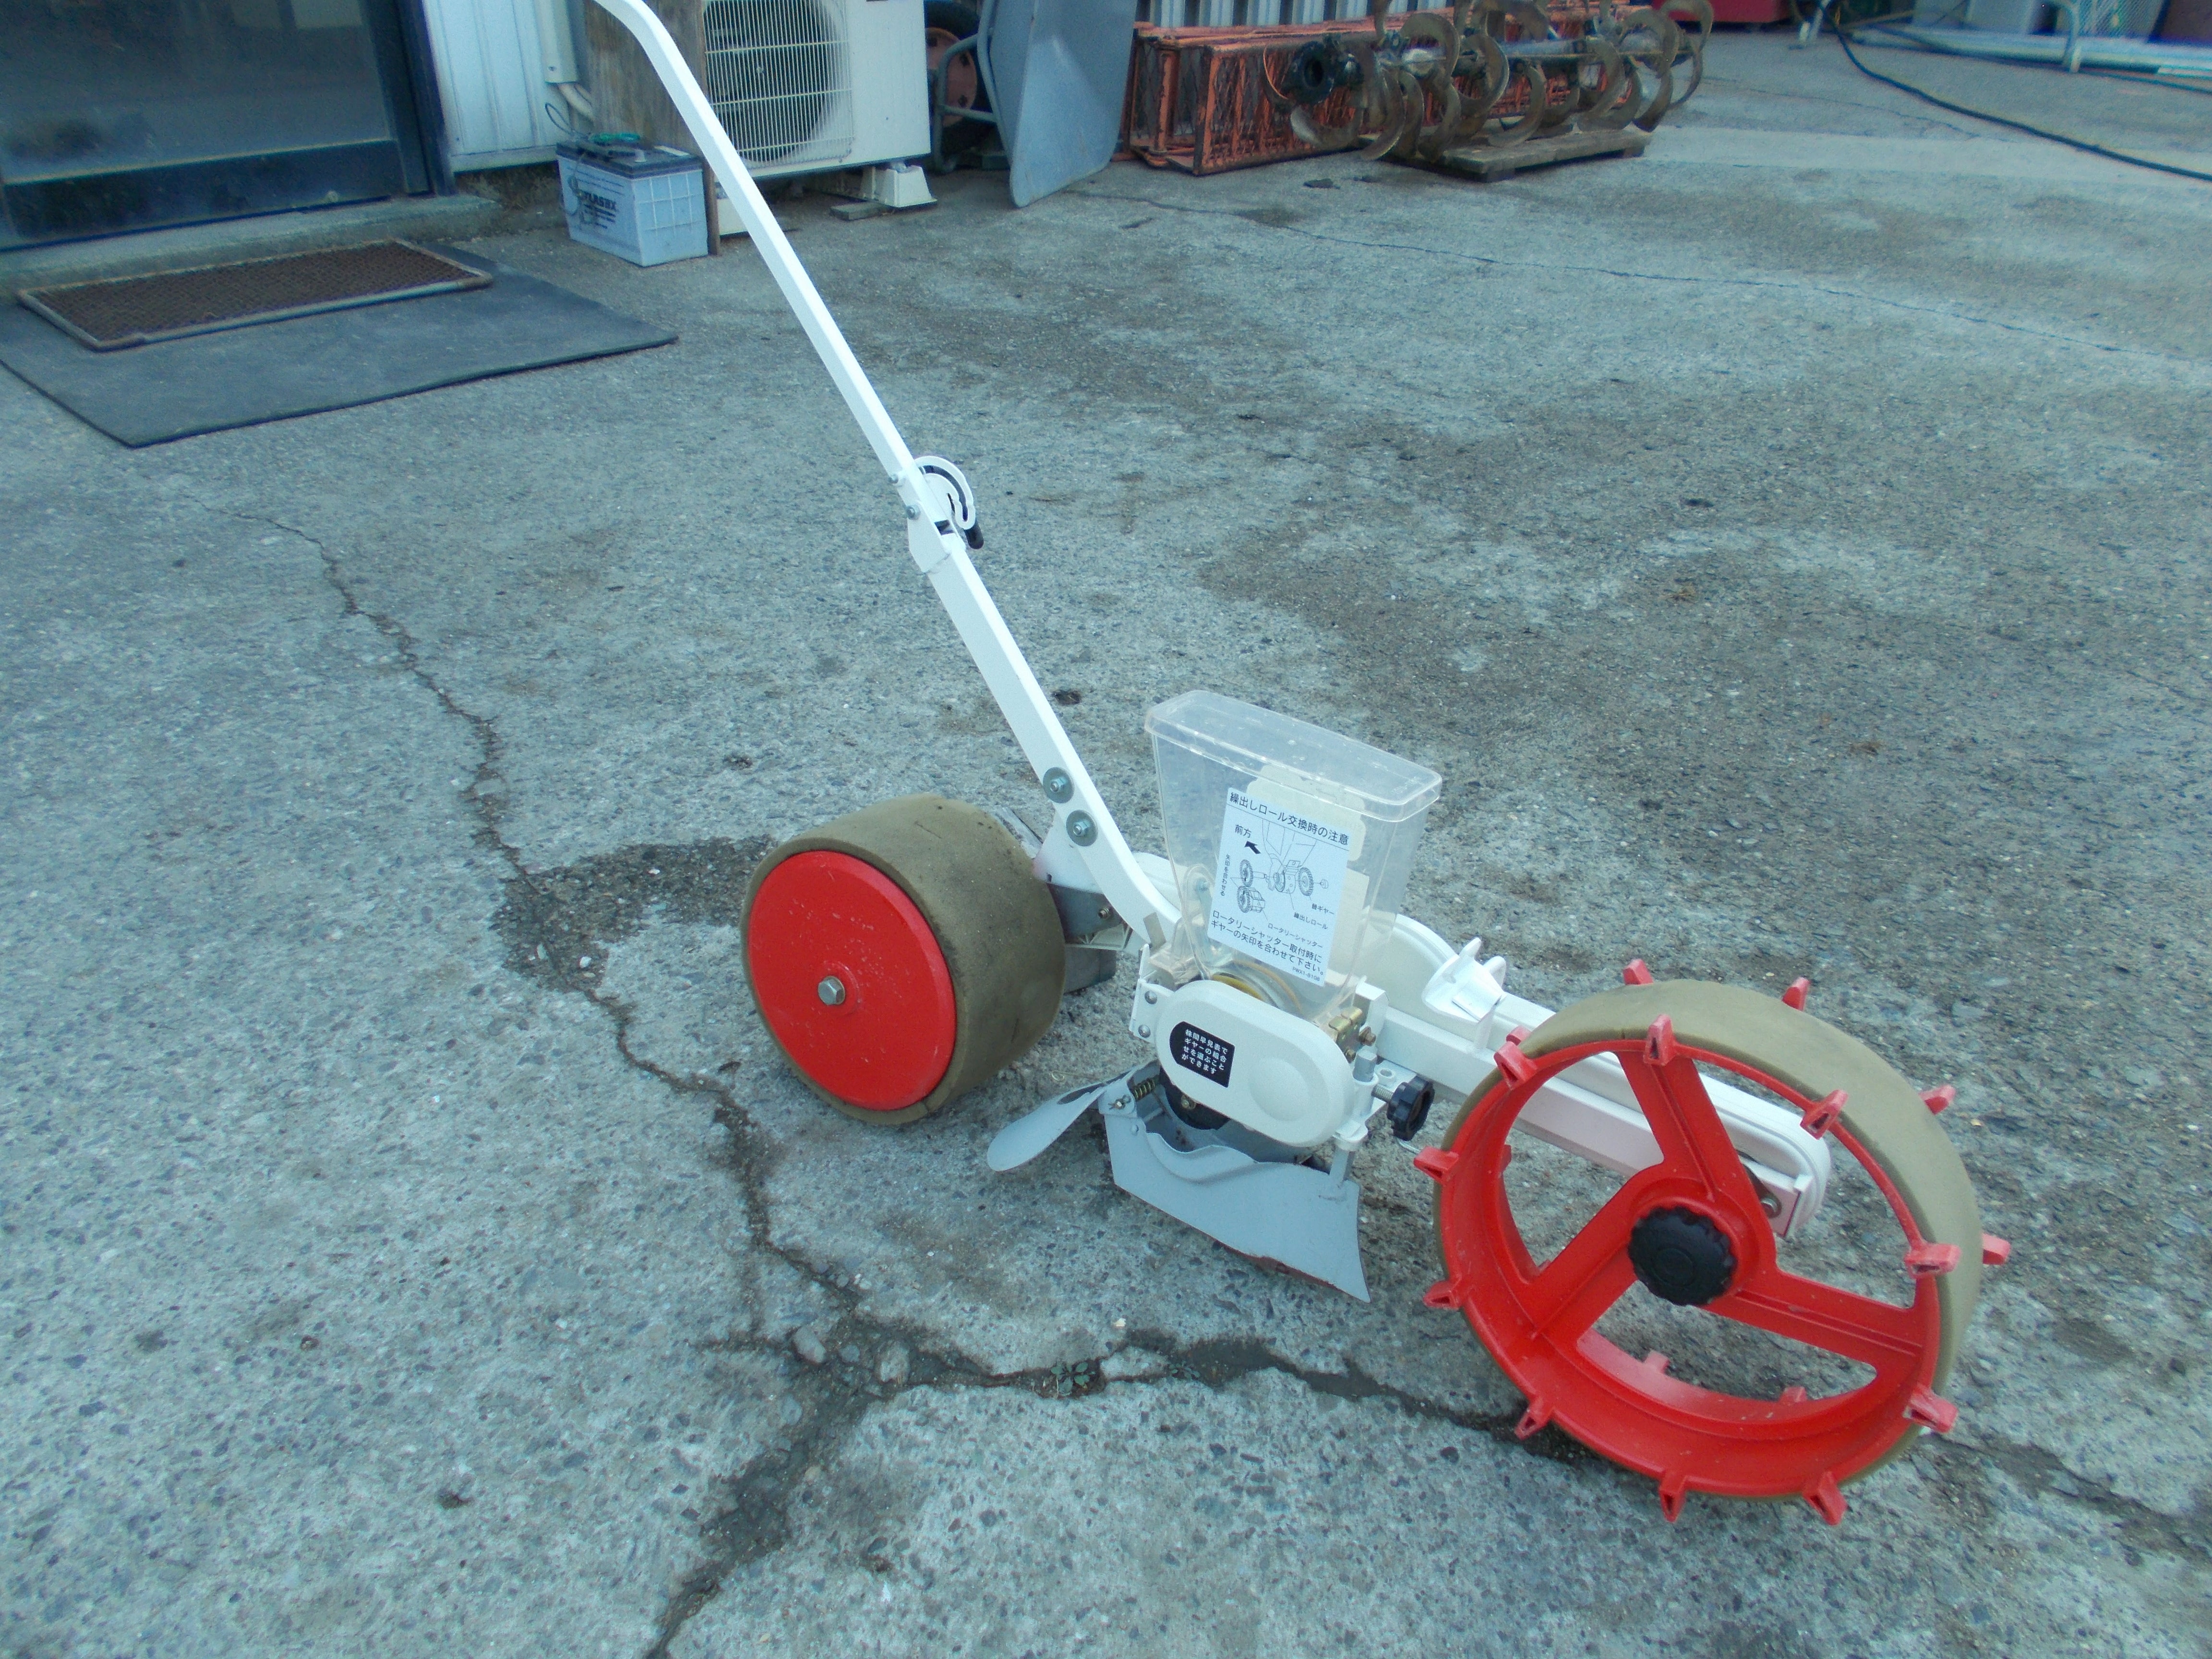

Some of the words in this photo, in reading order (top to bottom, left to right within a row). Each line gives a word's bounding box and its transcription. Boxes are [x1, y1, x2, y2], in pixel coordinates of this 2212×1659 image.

[1229, 792, 1349, 845] 繰出しロール交換時の注意
[1235, 824, 1252, 838] 前方
[1211, 920, 1323, 975] ギヤーの矢印を合わせて下さい。
[1213, 910, 1322, 963] ロータリーシャッター取付時に
[1268, 923, 1323, 948] ロータリーシャッター
[1184, 1038, 1227, 1063] ギヤーの組合
[1185, 1029, 1228, 1054] 株間早見表で
[1181, 1054, 1216, 1074] ができます
[1183, 1046, 1225, 1070] せを選ぶこと
